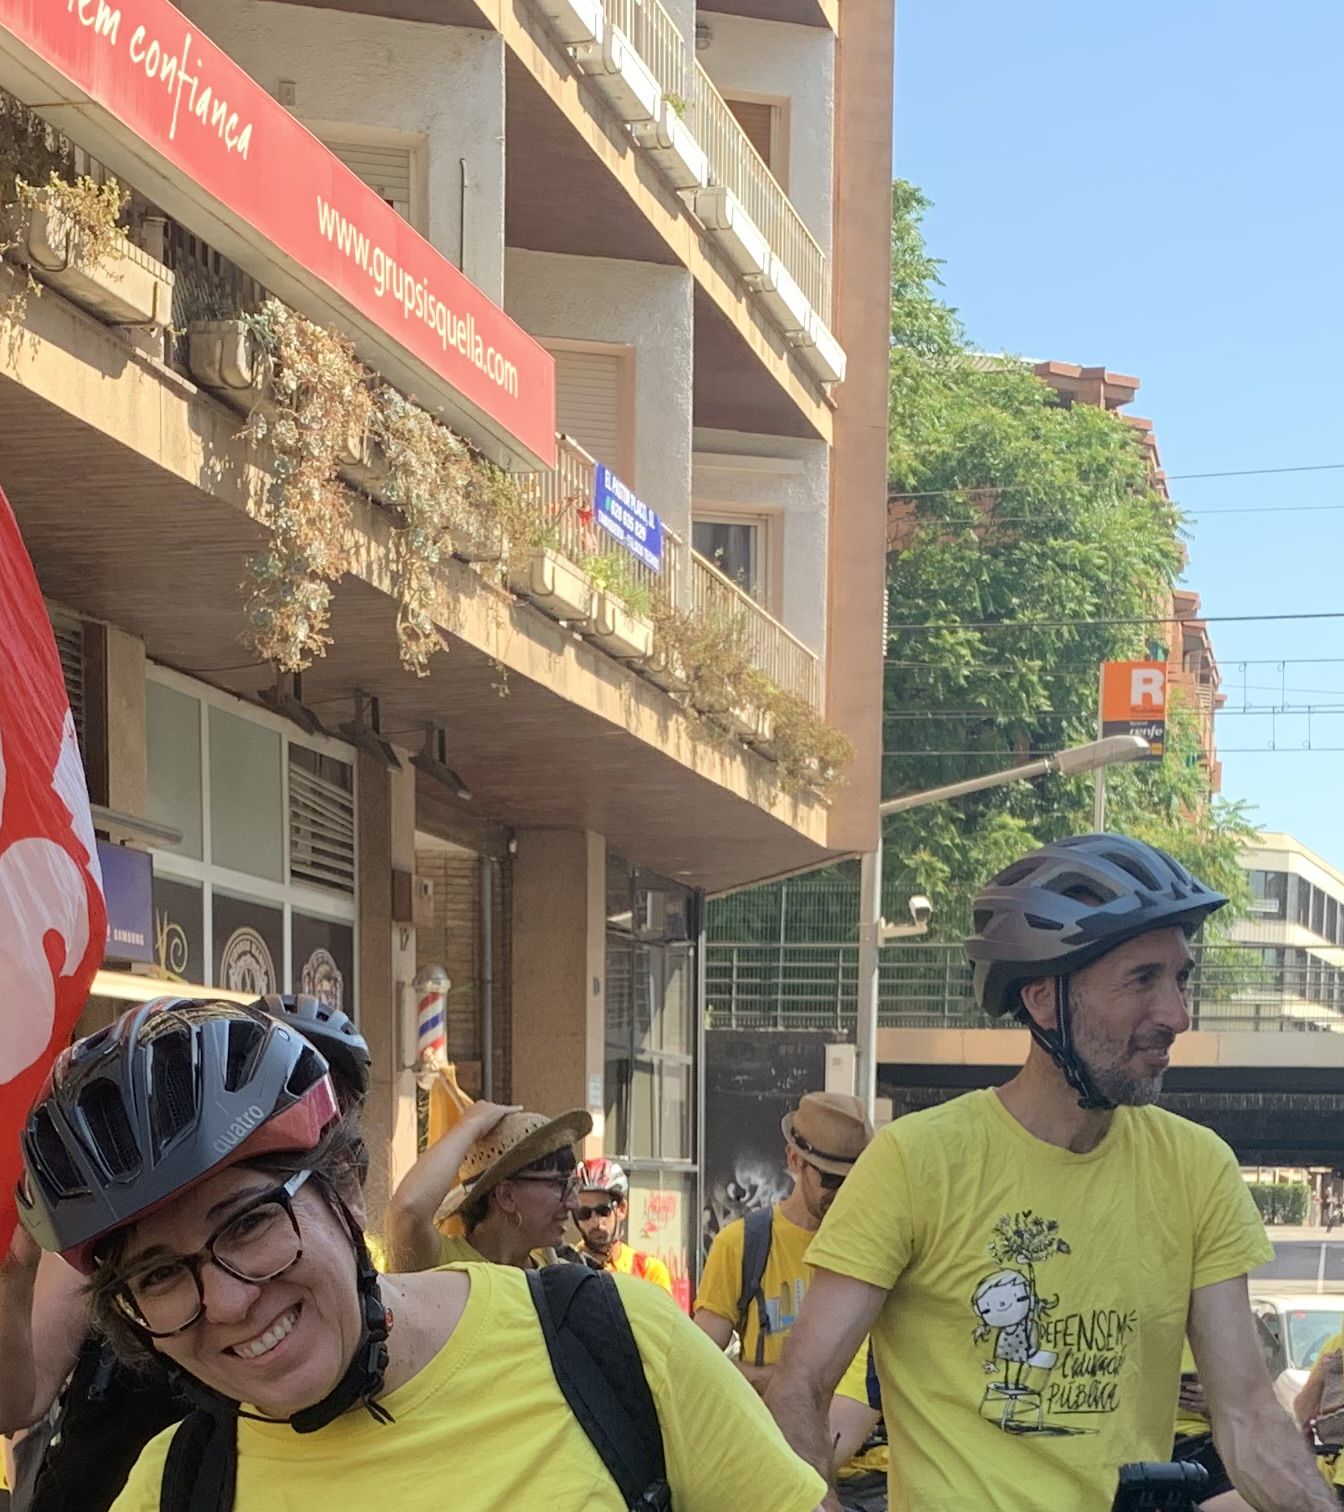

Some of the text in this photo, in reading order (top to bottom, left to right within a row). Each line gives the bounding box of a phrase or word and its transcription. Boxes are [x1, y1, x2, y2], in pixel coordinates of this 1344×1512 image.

[129, 25, 254, 161] confiança
[316, 194, 519, 399] www.grupsisquella.com
[1131, 668, 1165, 706] R
[212, 1104, 265, 1154] quatro
